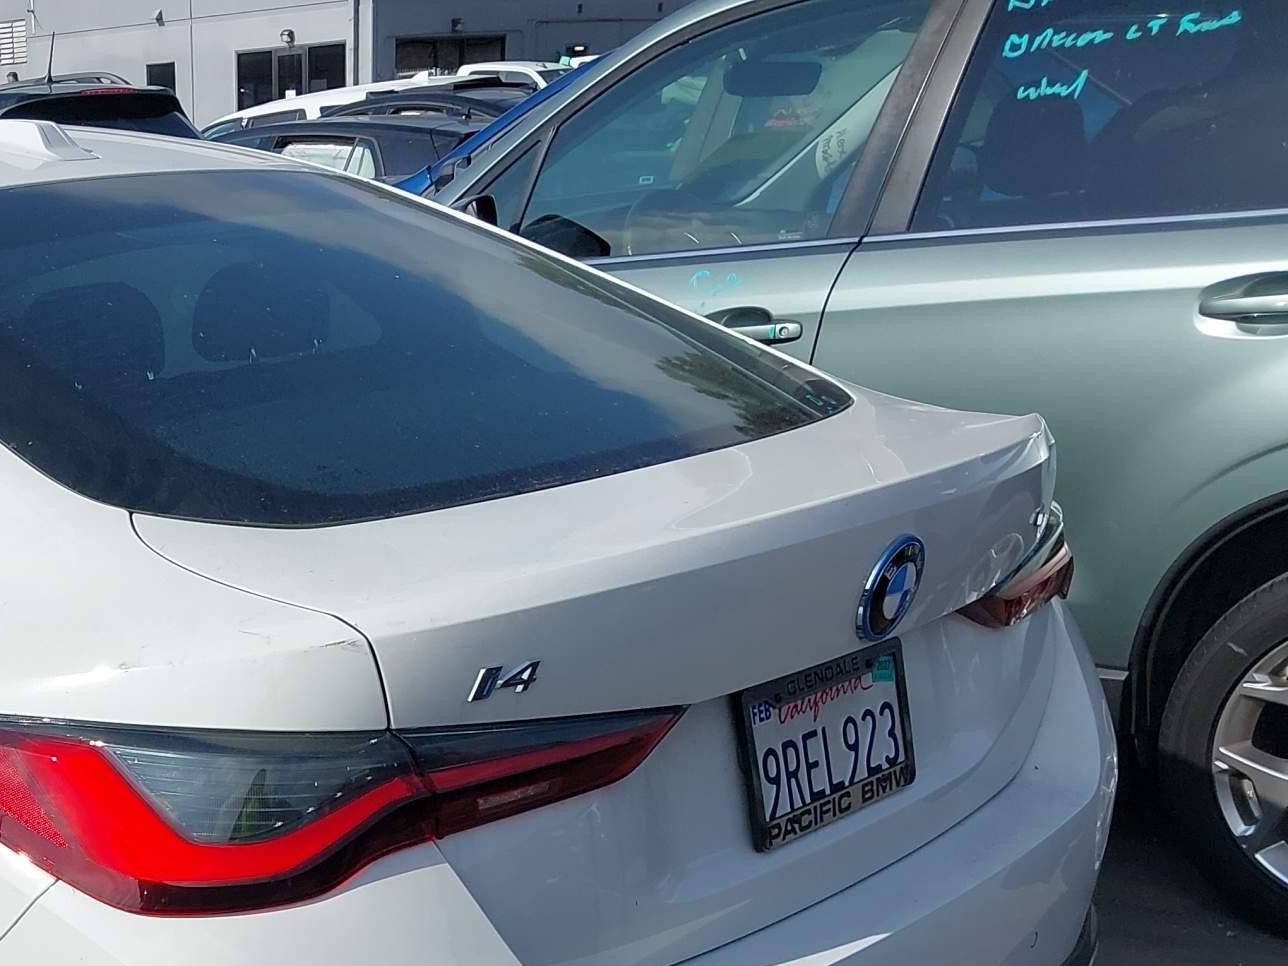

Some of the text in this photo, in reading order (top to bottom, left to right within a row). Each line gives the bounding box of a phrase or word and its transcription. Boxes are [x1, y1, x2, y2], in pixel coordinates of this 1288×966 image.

[466, 659, 541, 703] i4
[778, 674, 874, 725] California
[786, 656, 861, 697] GLENDALE
[752, 701, 772, 725] FEB
[763, 701, 900, 823] 9REL923
[766, 765, 909, 847] PACIFIC BMW
